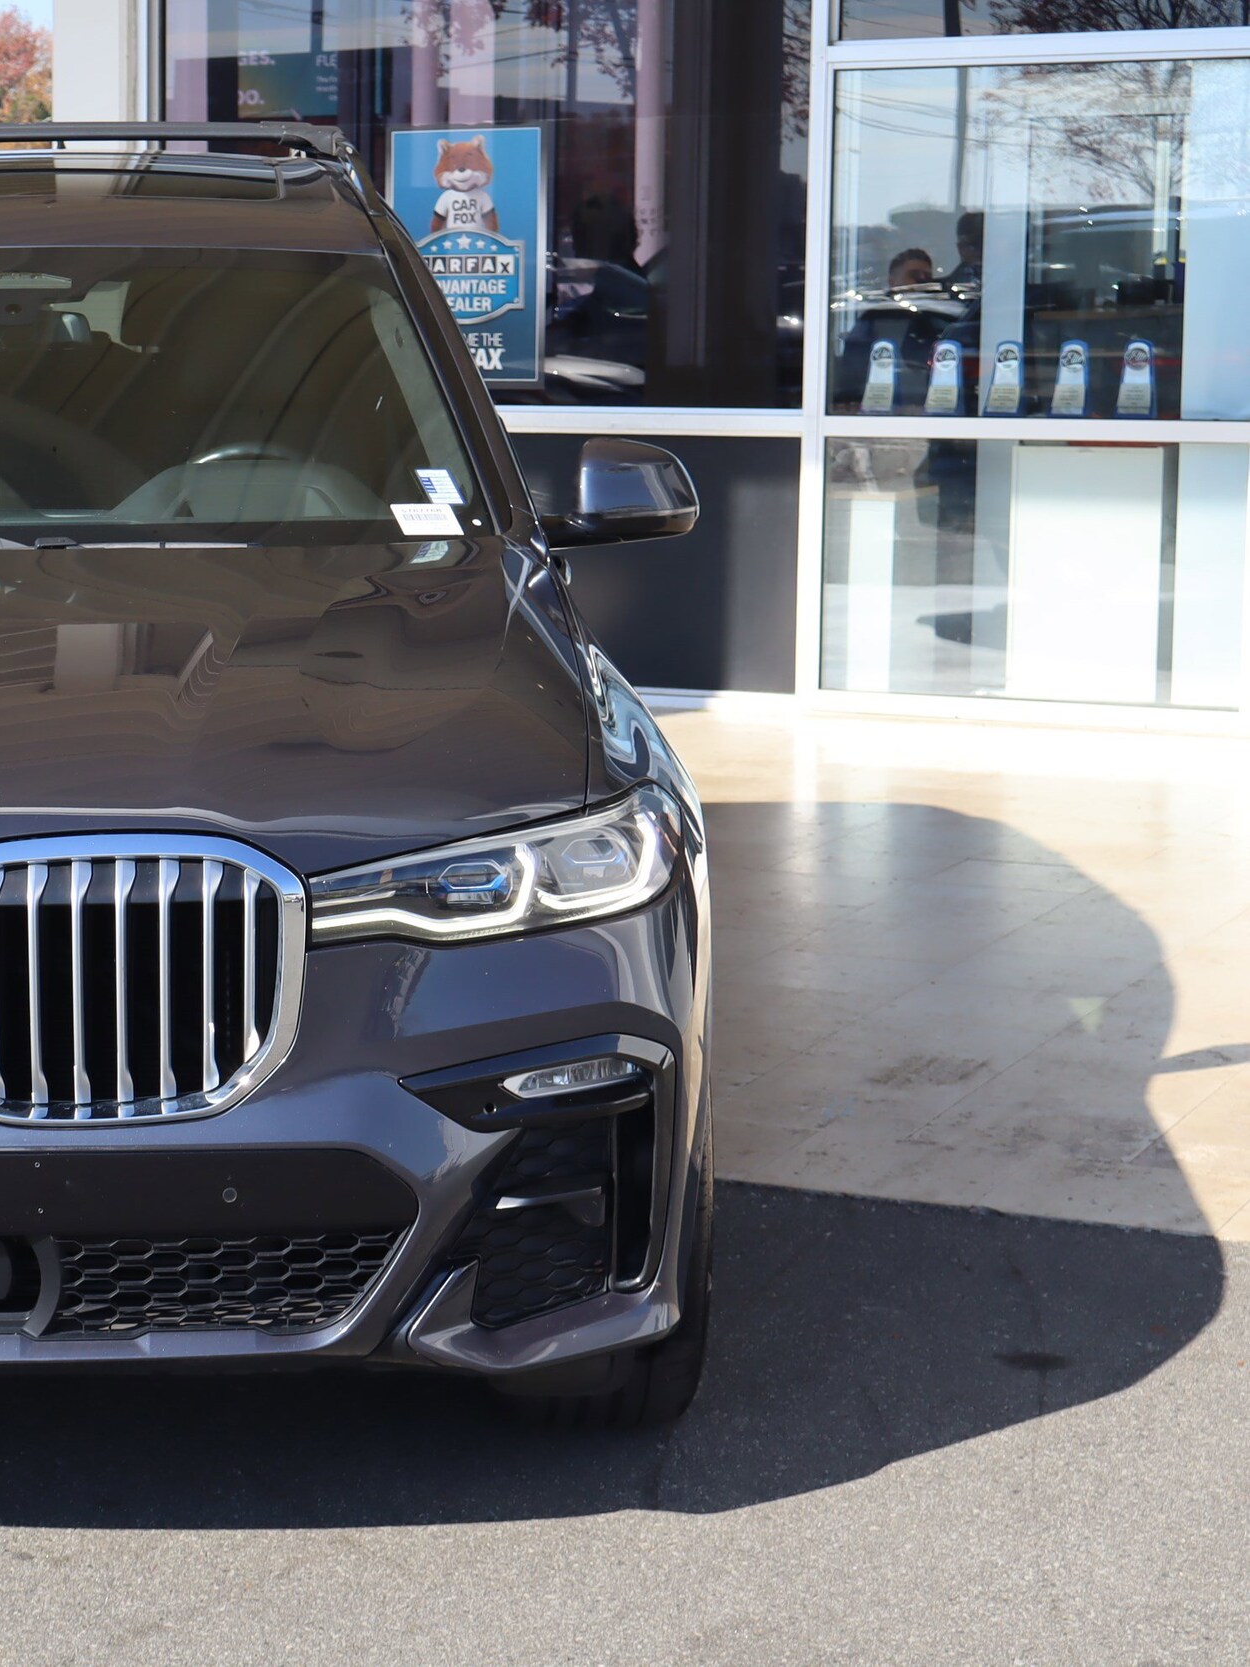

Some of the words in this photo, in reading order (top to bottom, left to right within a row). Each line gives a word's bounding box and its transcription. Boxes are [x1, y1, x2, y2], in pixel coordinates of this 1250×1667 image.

[452, 198, 478, 212] CAR
[453, 212, 477, 224] FOX
[436, 279, 507, 294] VANTAGE
[447, 296, 492, 312] EALER
[480, 332, 503, 347] THE
